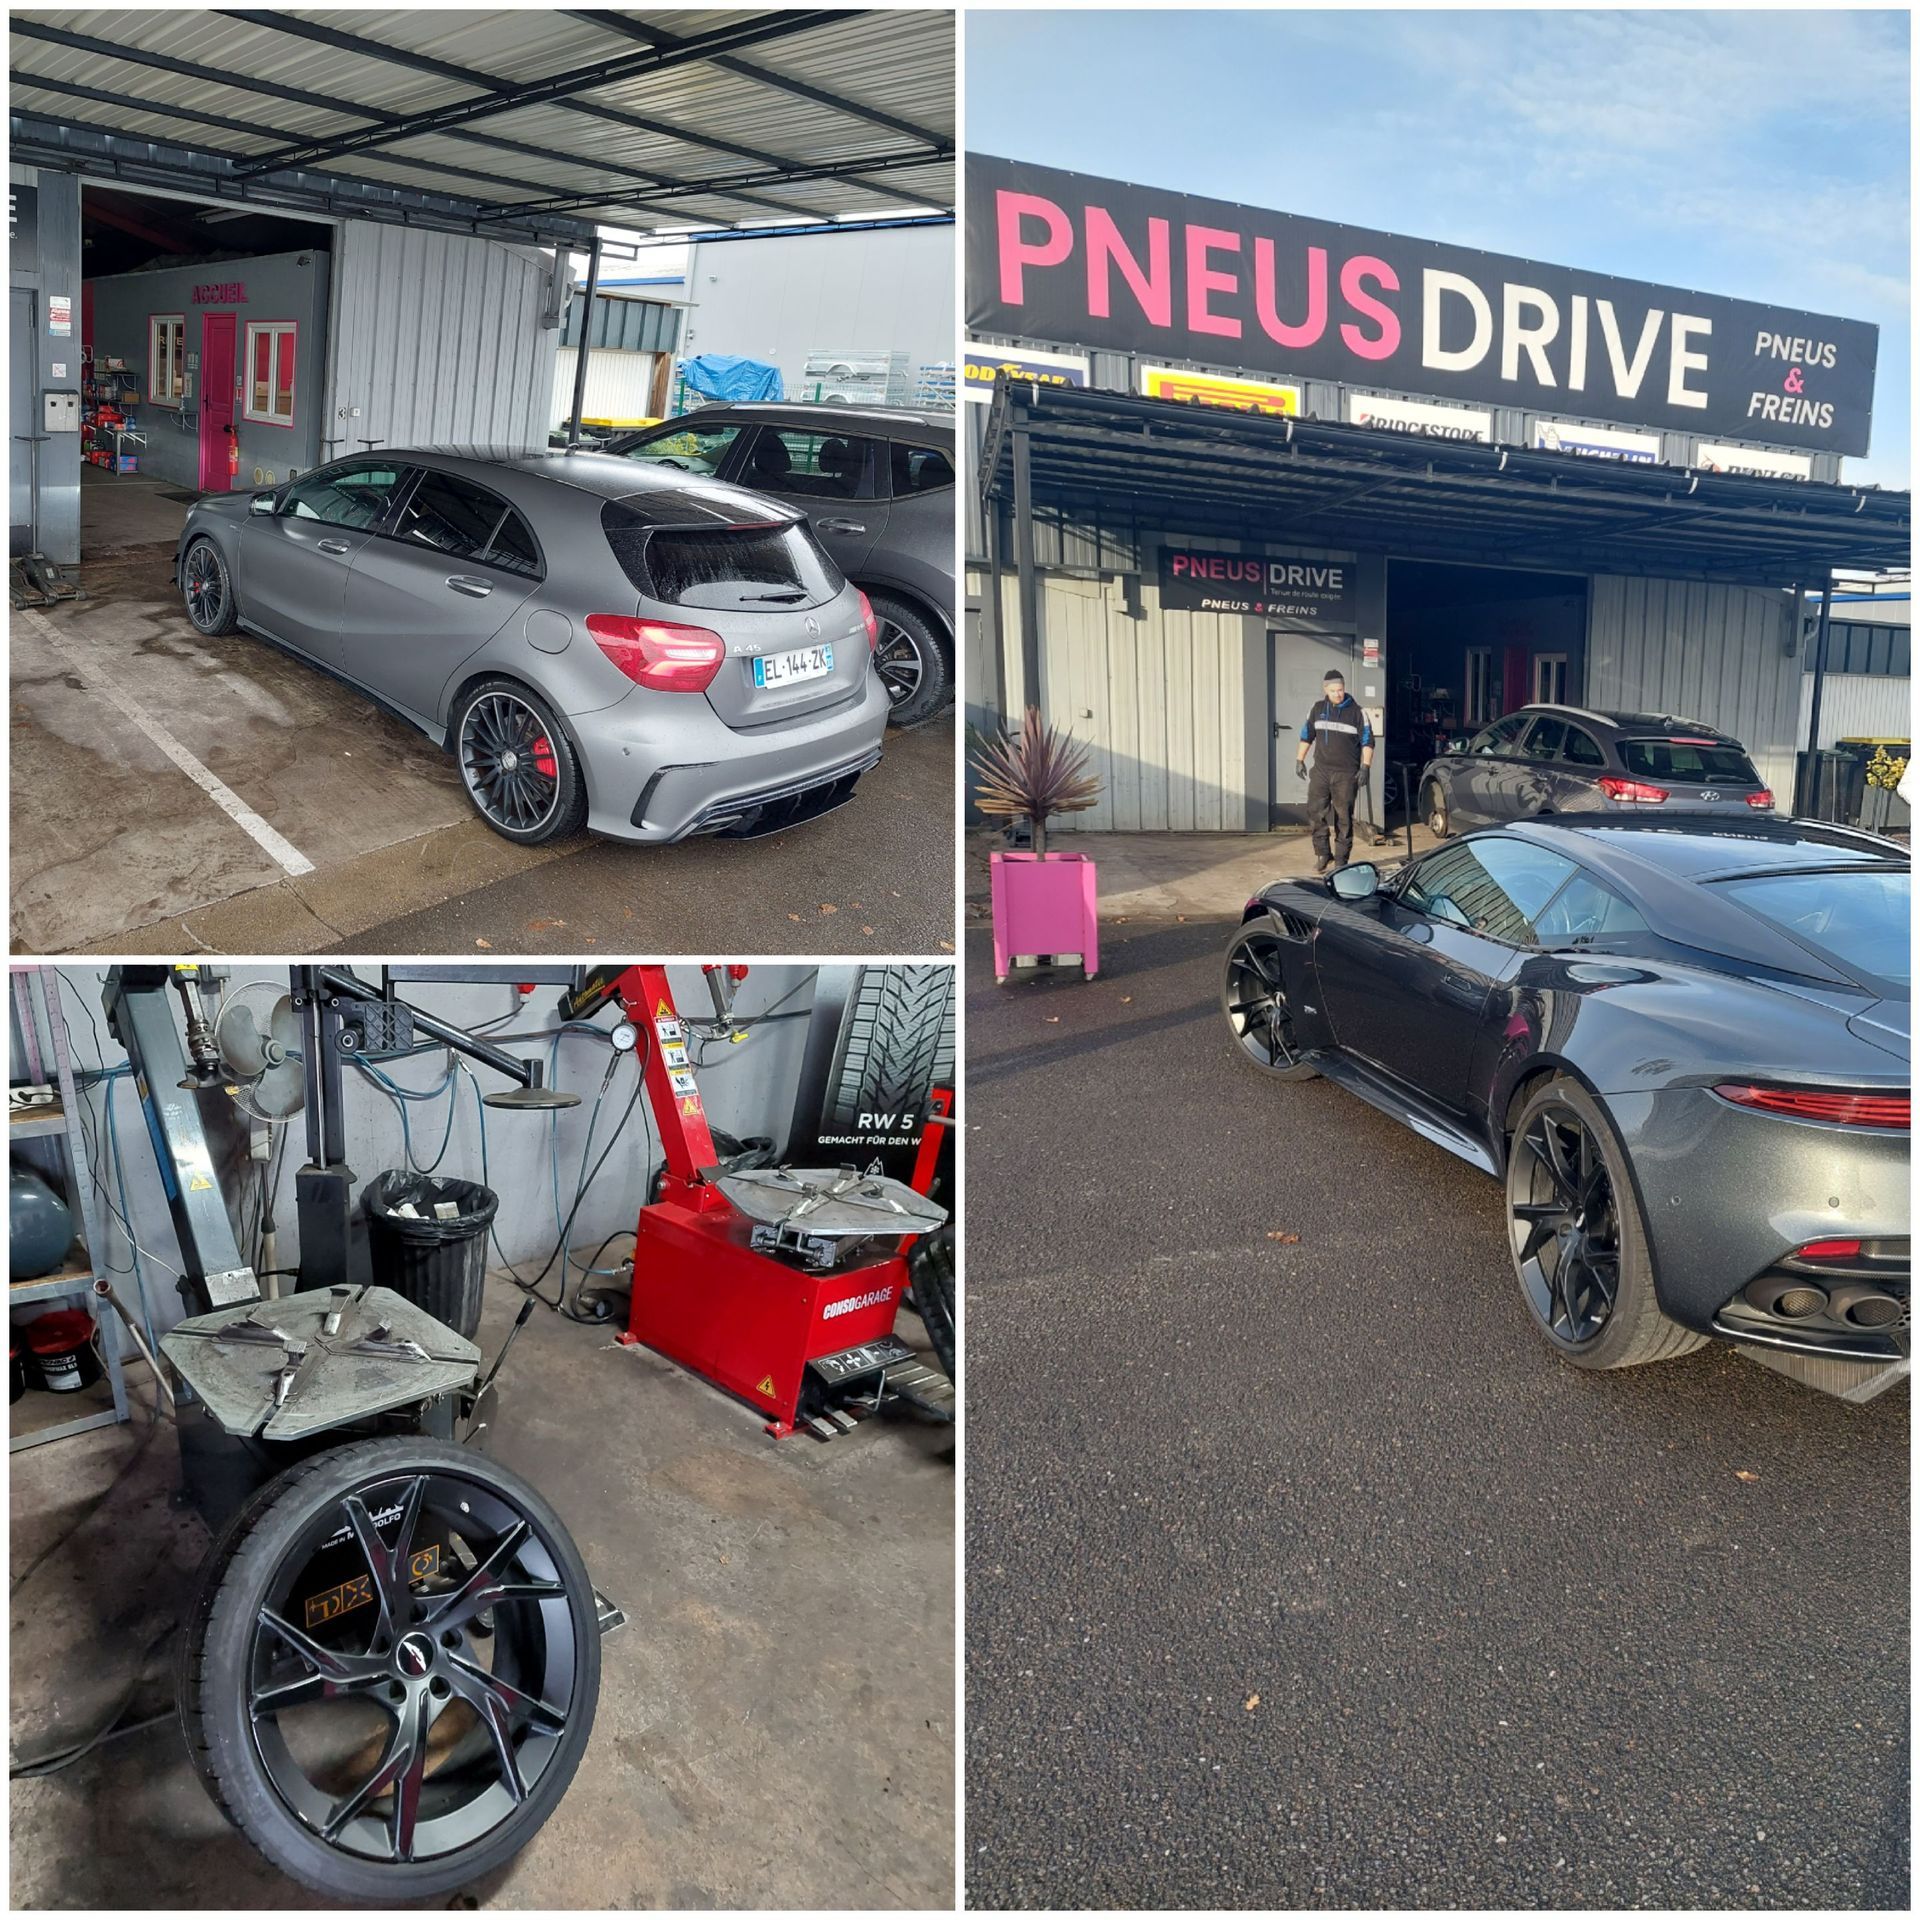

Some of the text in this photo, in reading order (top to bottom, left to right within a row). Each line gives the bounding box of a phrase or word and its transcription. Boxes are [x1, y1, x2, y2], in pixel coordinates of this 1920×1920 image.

[192, 283, 248, 304] ACCUEIL
[996, 189, 1713, 409] PNEUS DRIVE
[1755, 331, 1837, 368] PNEUS
[1784, 367, 1804, 393] &
[1747, 392, 1834, 428] FREINS
[1173, 555, 1343, 589] PNEUS DRIVE
[1202, 599, 1317, 616] PNEUS & FREINS
[858, 1113, 914, 1129] RW 5
[818, 1136, 865, 1144] GEMACHT
[866, 1135, 886, 1145] FÜR
[888, 1137, 908, 1145] DEN
[823, 1286, 893, 1320] CONSOGARAGE
[321, 1539, 338, 1550] MADE
